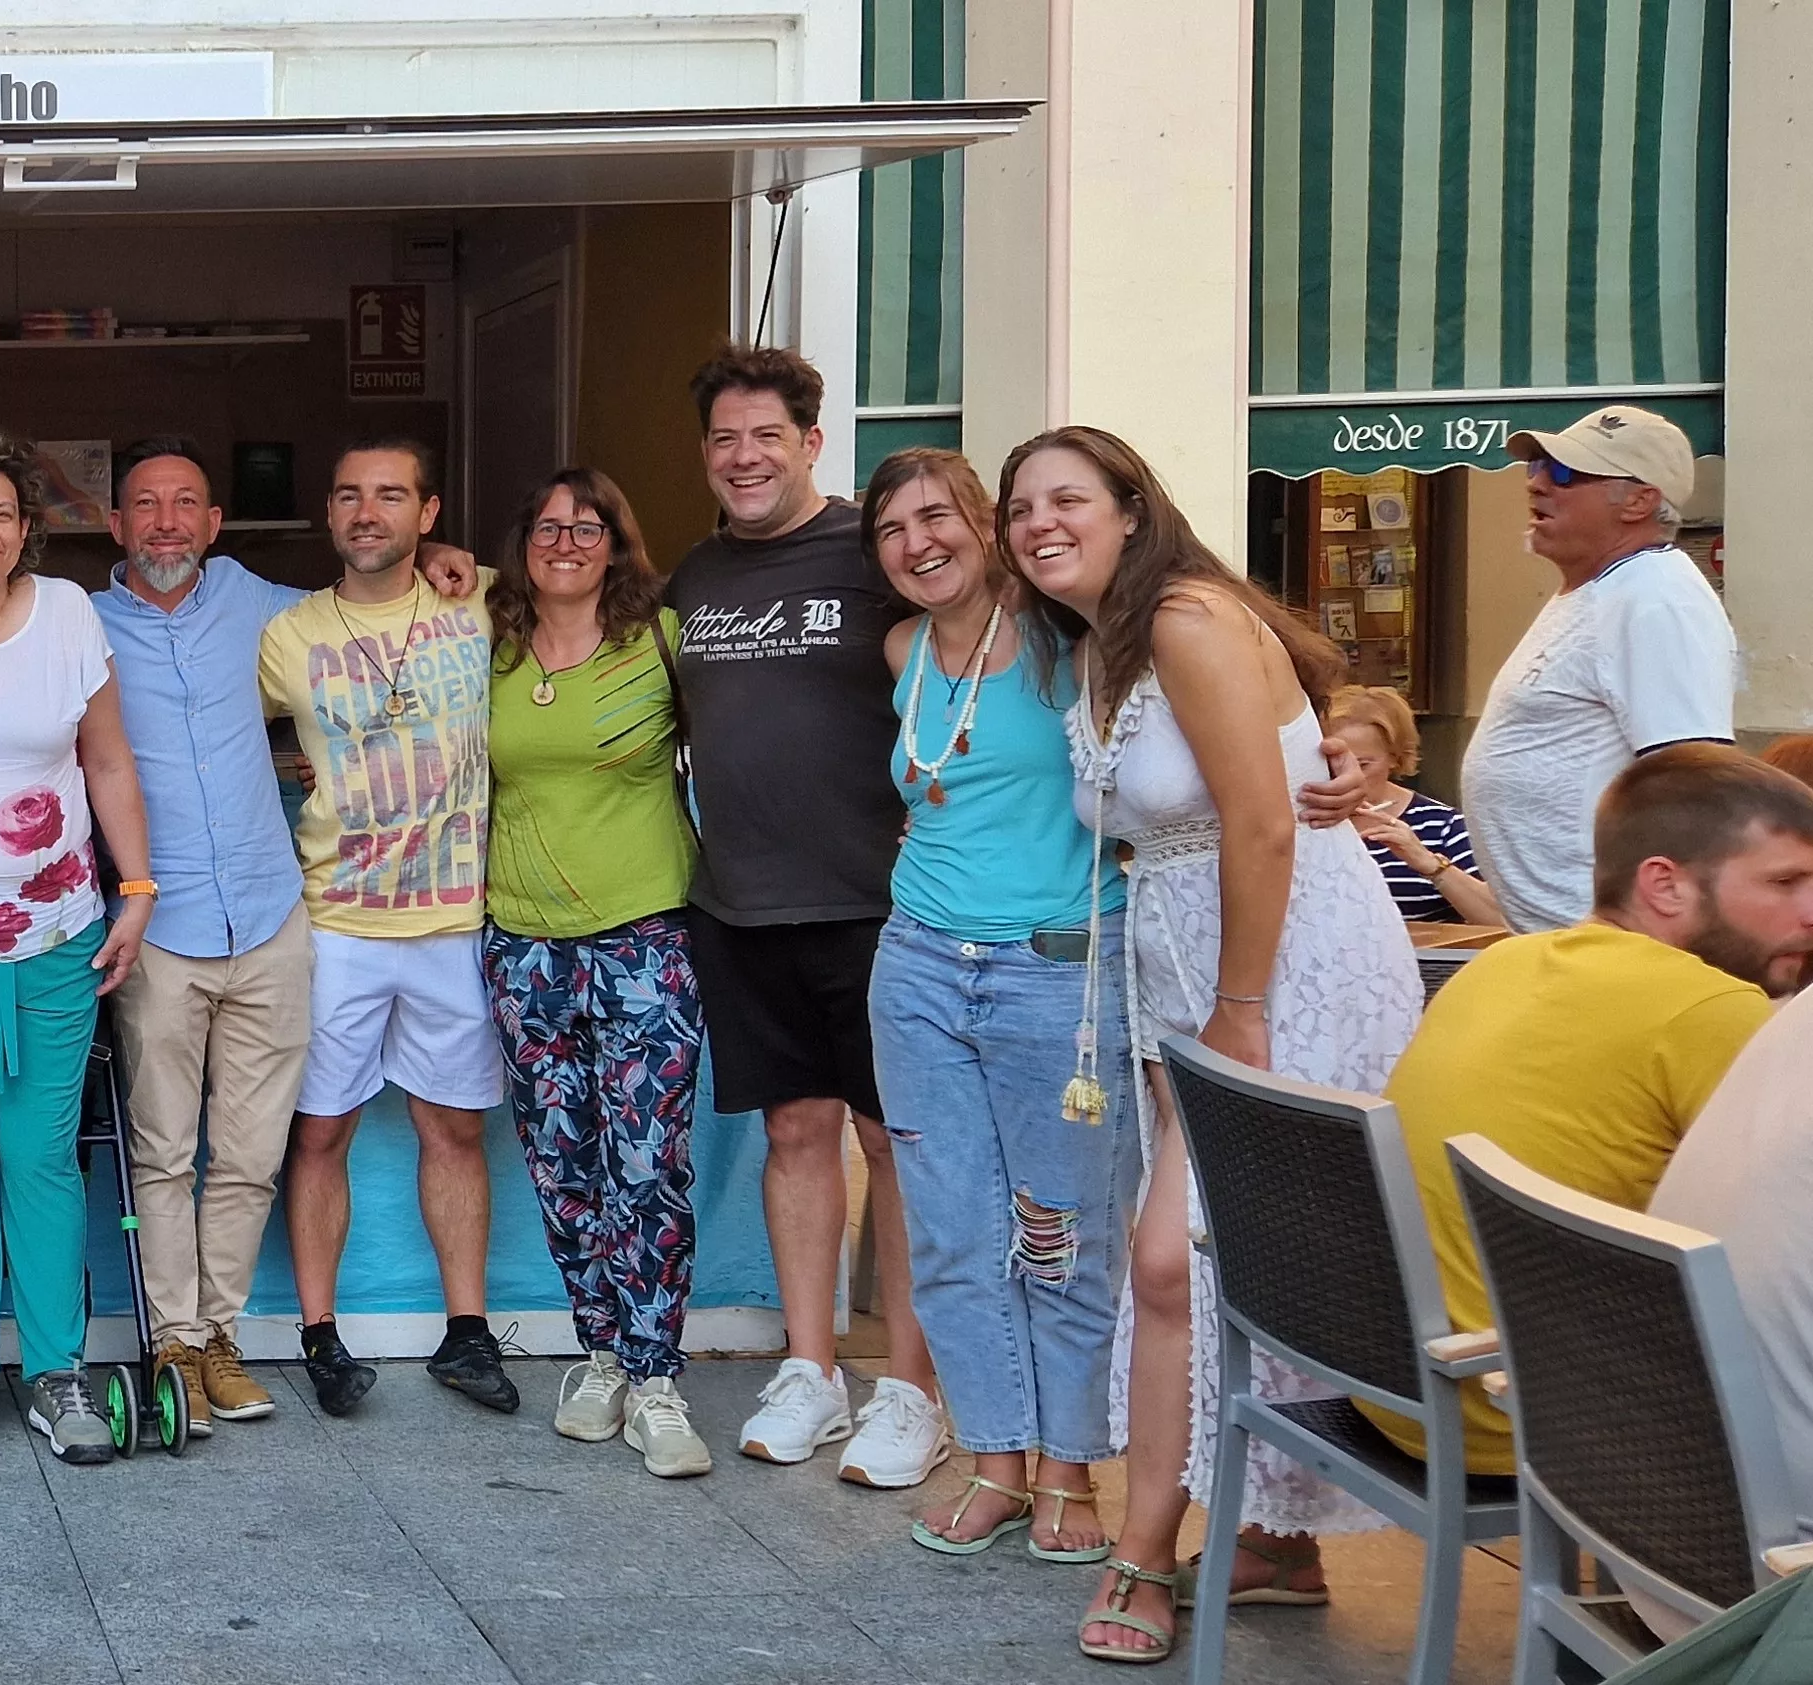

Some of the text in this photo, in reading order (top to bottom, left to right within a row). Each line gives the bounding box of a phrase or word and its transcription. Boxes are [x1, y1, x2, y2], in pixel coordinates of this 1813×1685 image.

[353, 371, 421, 388] EXTINTOR
[1333, 413, 1510, 456] desde 1871
[679, 599, 842, 657] Attitude B
[708, 643, 734, 653] LOOK
[735, 641, 760, 651] BACK
[779, 637, 799, 647] ALL
[703, 646, 809, 662] HAPPINESS IS THE WAY
